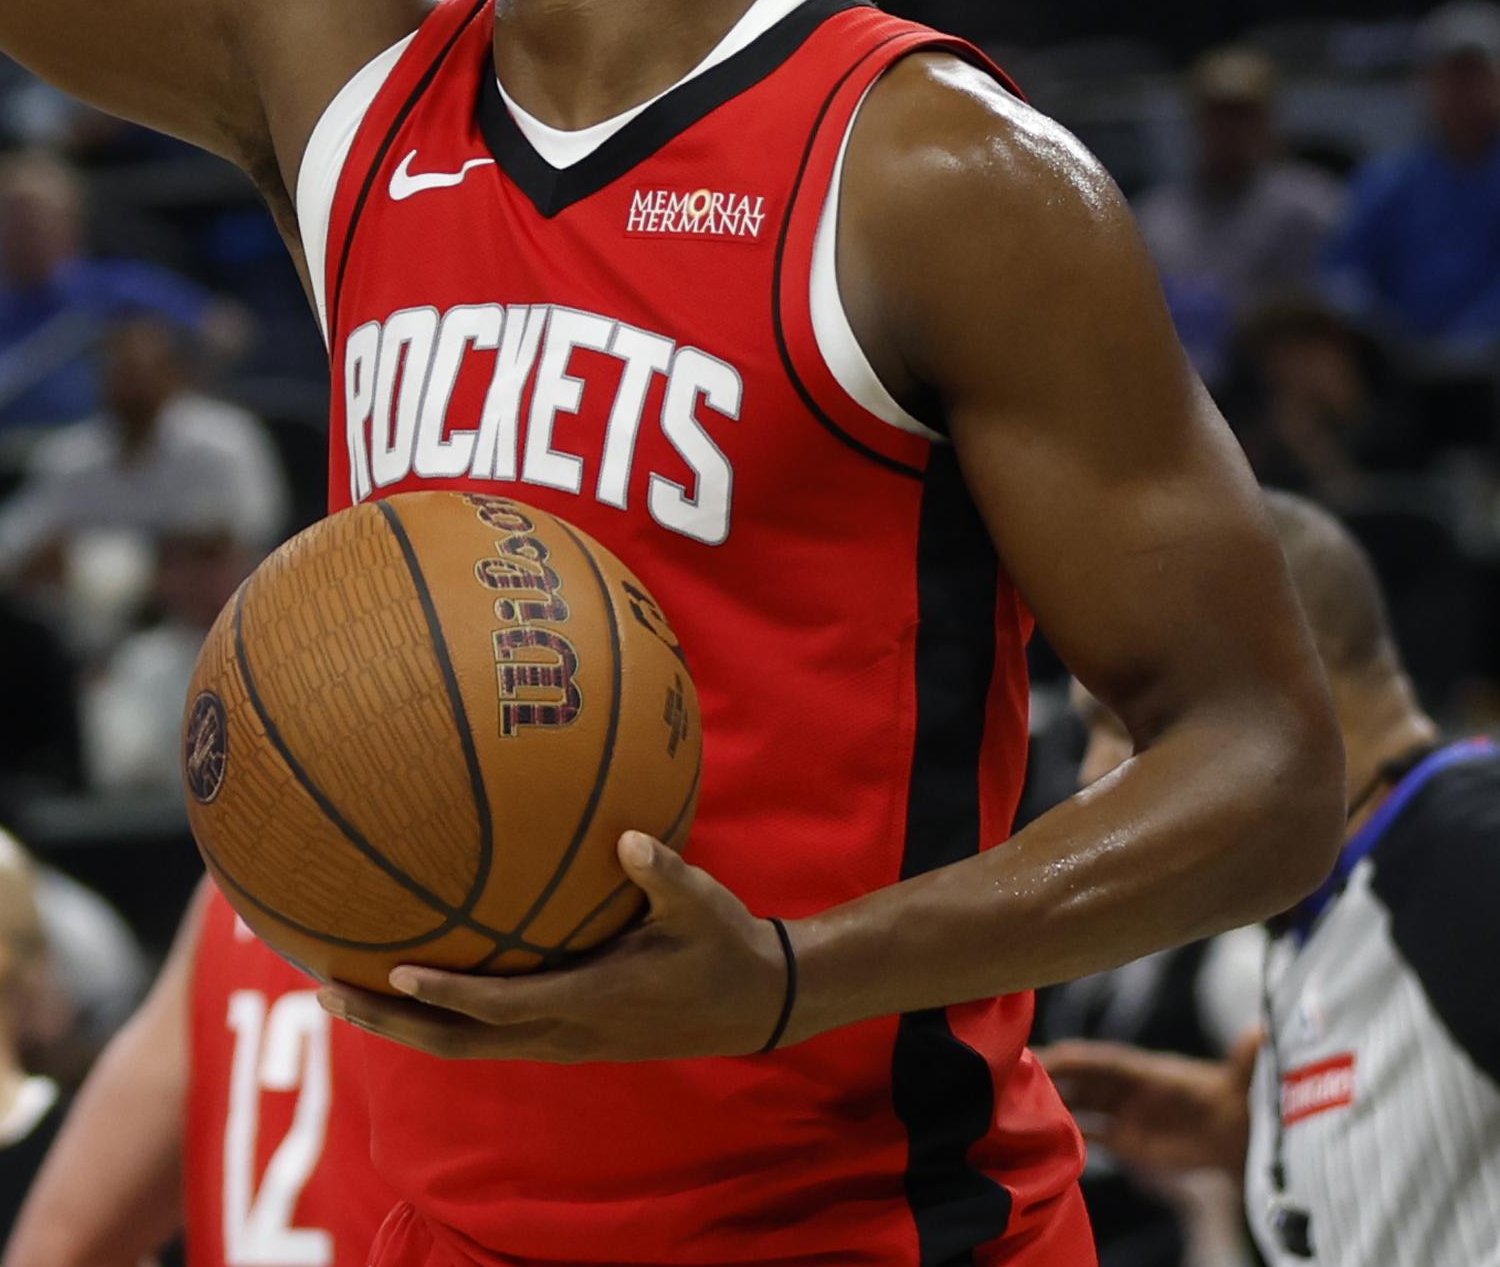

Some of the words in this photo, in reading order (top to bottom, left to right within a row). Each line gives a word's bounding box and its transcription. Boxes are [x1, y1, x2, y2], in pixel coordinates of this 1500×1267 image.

[626, 210, 763, 238] HERMANN
[630, 189, 766, 220] MEMORIAL
[344, 302, 743, 546] ROCKETS
[224, 988, 334, 1267] 12
